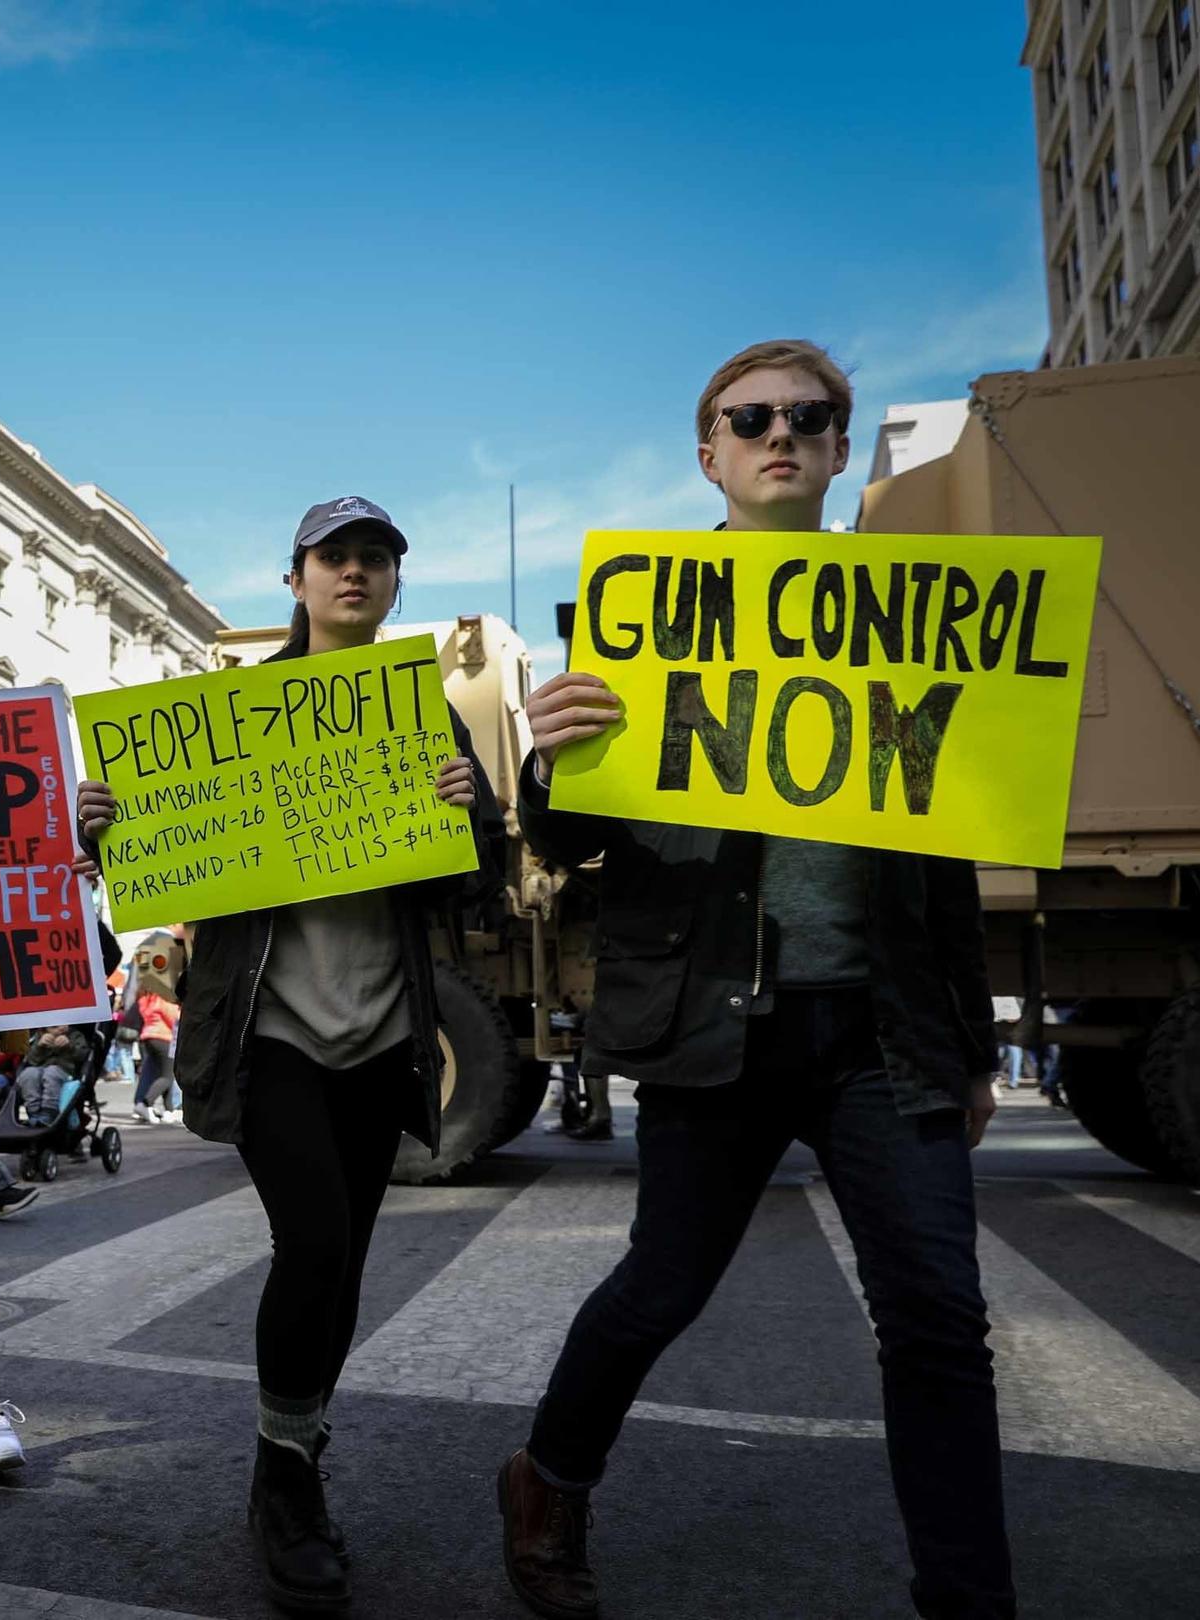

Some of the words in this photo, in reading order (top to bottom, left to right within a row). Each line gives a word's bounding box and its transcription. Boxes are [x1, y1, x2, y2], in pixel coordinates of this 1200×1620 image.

[587, 553, 735, 662] GUN
[767, 558, 1068, 678] CONTROL
[656, 669, 964, 815] NOW
[107, 770, 263, 826] OLUMBINE-13
[49, 928, 81, 952] ON
[47, 959, 91, 994] YOU
